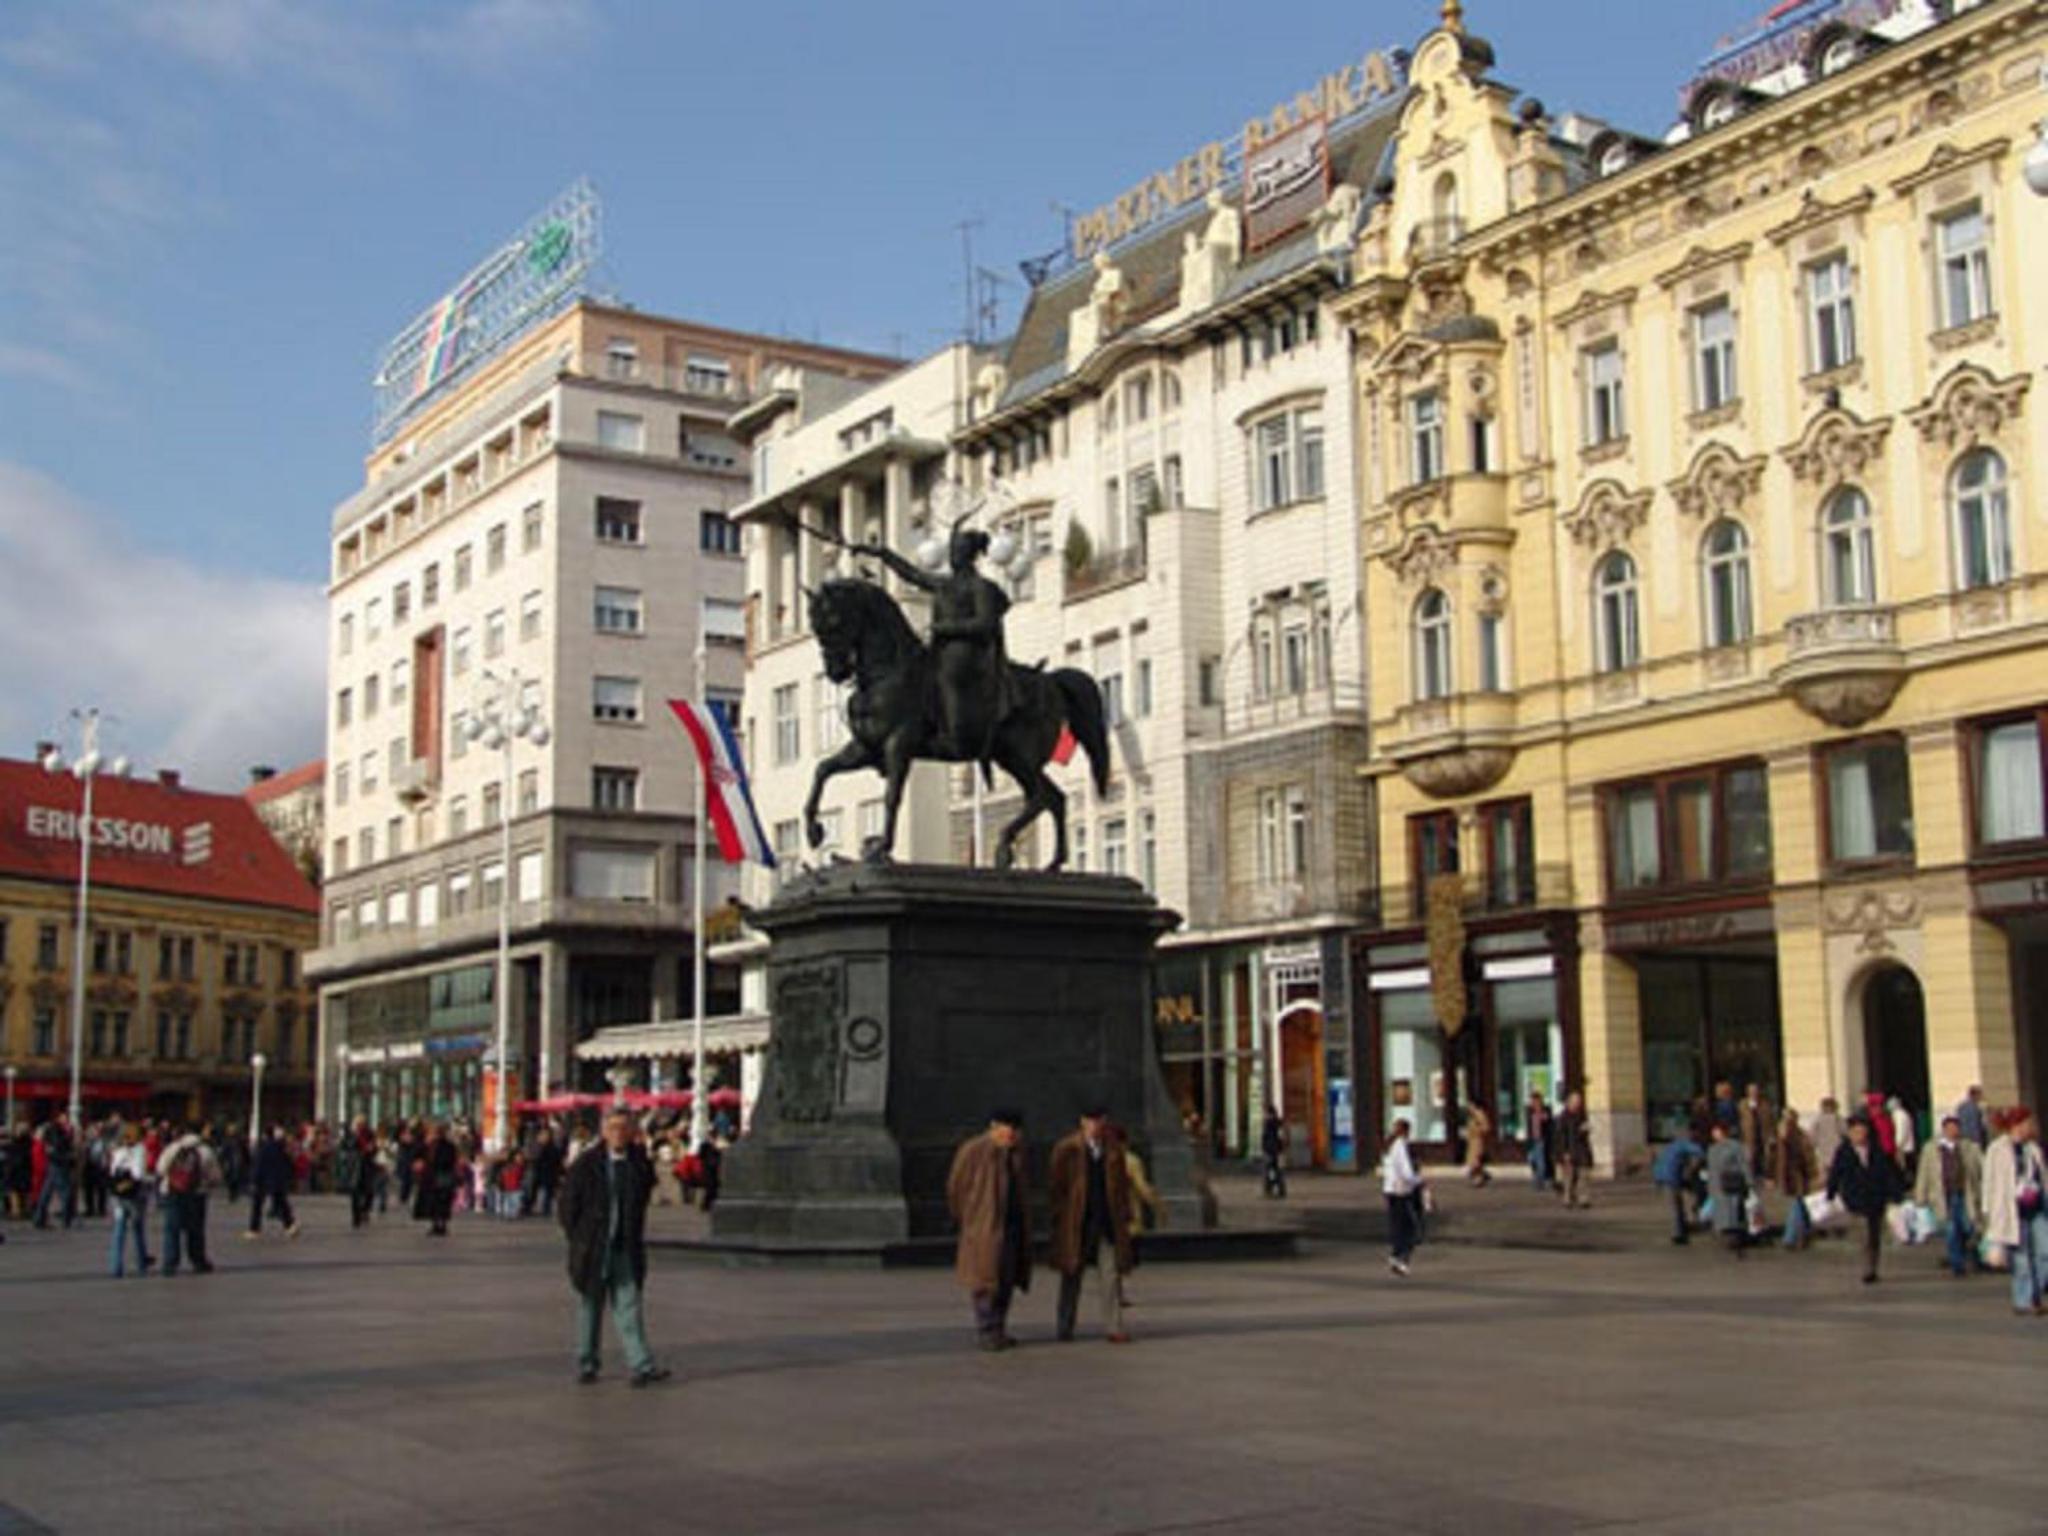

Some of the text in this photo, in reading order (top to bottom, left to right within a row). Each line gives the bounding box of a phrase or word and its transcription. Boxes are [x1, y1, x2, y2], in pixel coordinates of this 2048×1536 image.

[1073, 51, 1395, 259] PARTNER BANKA
[26, 805, 172, 852] ERICSSON
